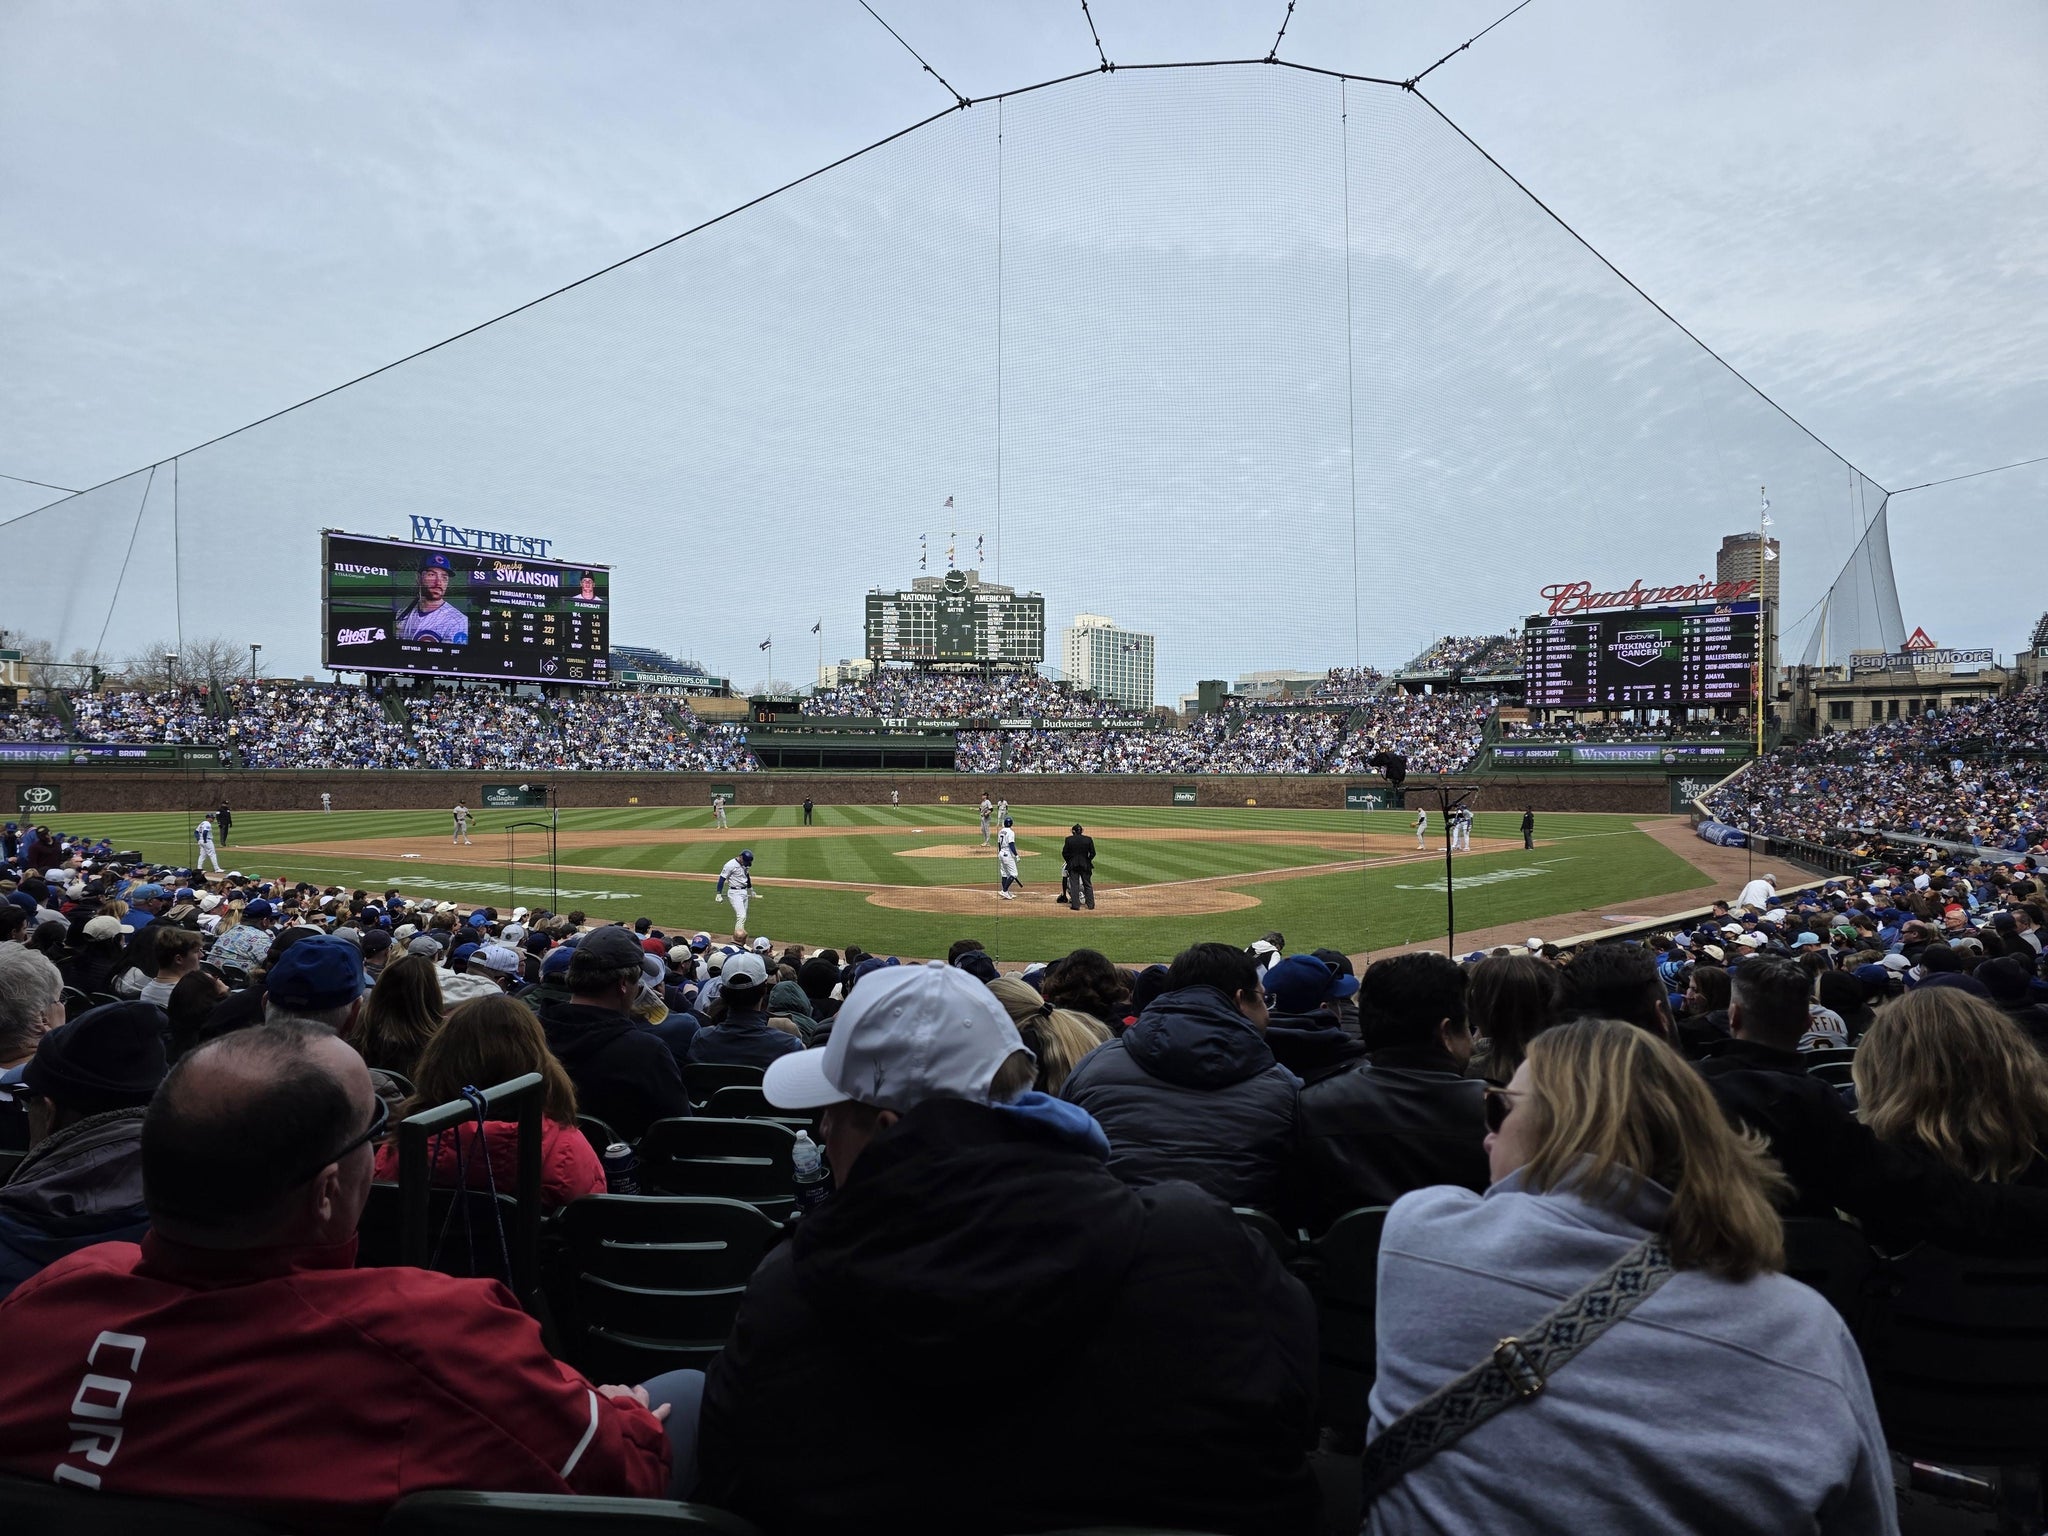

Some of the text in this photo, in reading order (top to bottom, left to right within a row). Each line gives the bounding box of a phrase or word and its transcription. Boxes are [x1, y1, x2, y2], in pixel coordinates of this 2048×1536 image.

[409, 515, 552, 558] WINTRUST
[476, 557, 482, 566] 7
[334, 563, 389, 576] nuveen
[474, 571, 485, 580] SS
[496, 569, 559, 587] SWANSON
[499, 590, 526, 598] FEBRUARY
[974, 594, 1011, 602] AMERICAN
[1541, 574, 1759, 615] Budweiser
[511, 599, 538, 607] MARIETTA,
[1714, 606, 1732, 614] Cubs
[542, 614, 555, 622] .136
[542, 626, 555, 634] .227
[337, 627, 377, 646] GHOST
[542, 638, 555, 646] .491
[1608, 642, 1652, 651] STRIKING
[1622, 649, 1658, 657] CANCER
[1705, 653, 1741, 661] BALLESTEROS
[1850, 650, 1993, 669] Benjamin Moore
[569, 666, 583, 678] 85
[636, 673, 709, 685] WRIGLEYROOFTOPS.COM
[772, 695, 792, 703] Mobile
[1608, 691, 1671, 701] 4 2 2 3
[881, 718, 907, 727] YETI
[1579, 748, 1655, 761] WINTRUST
